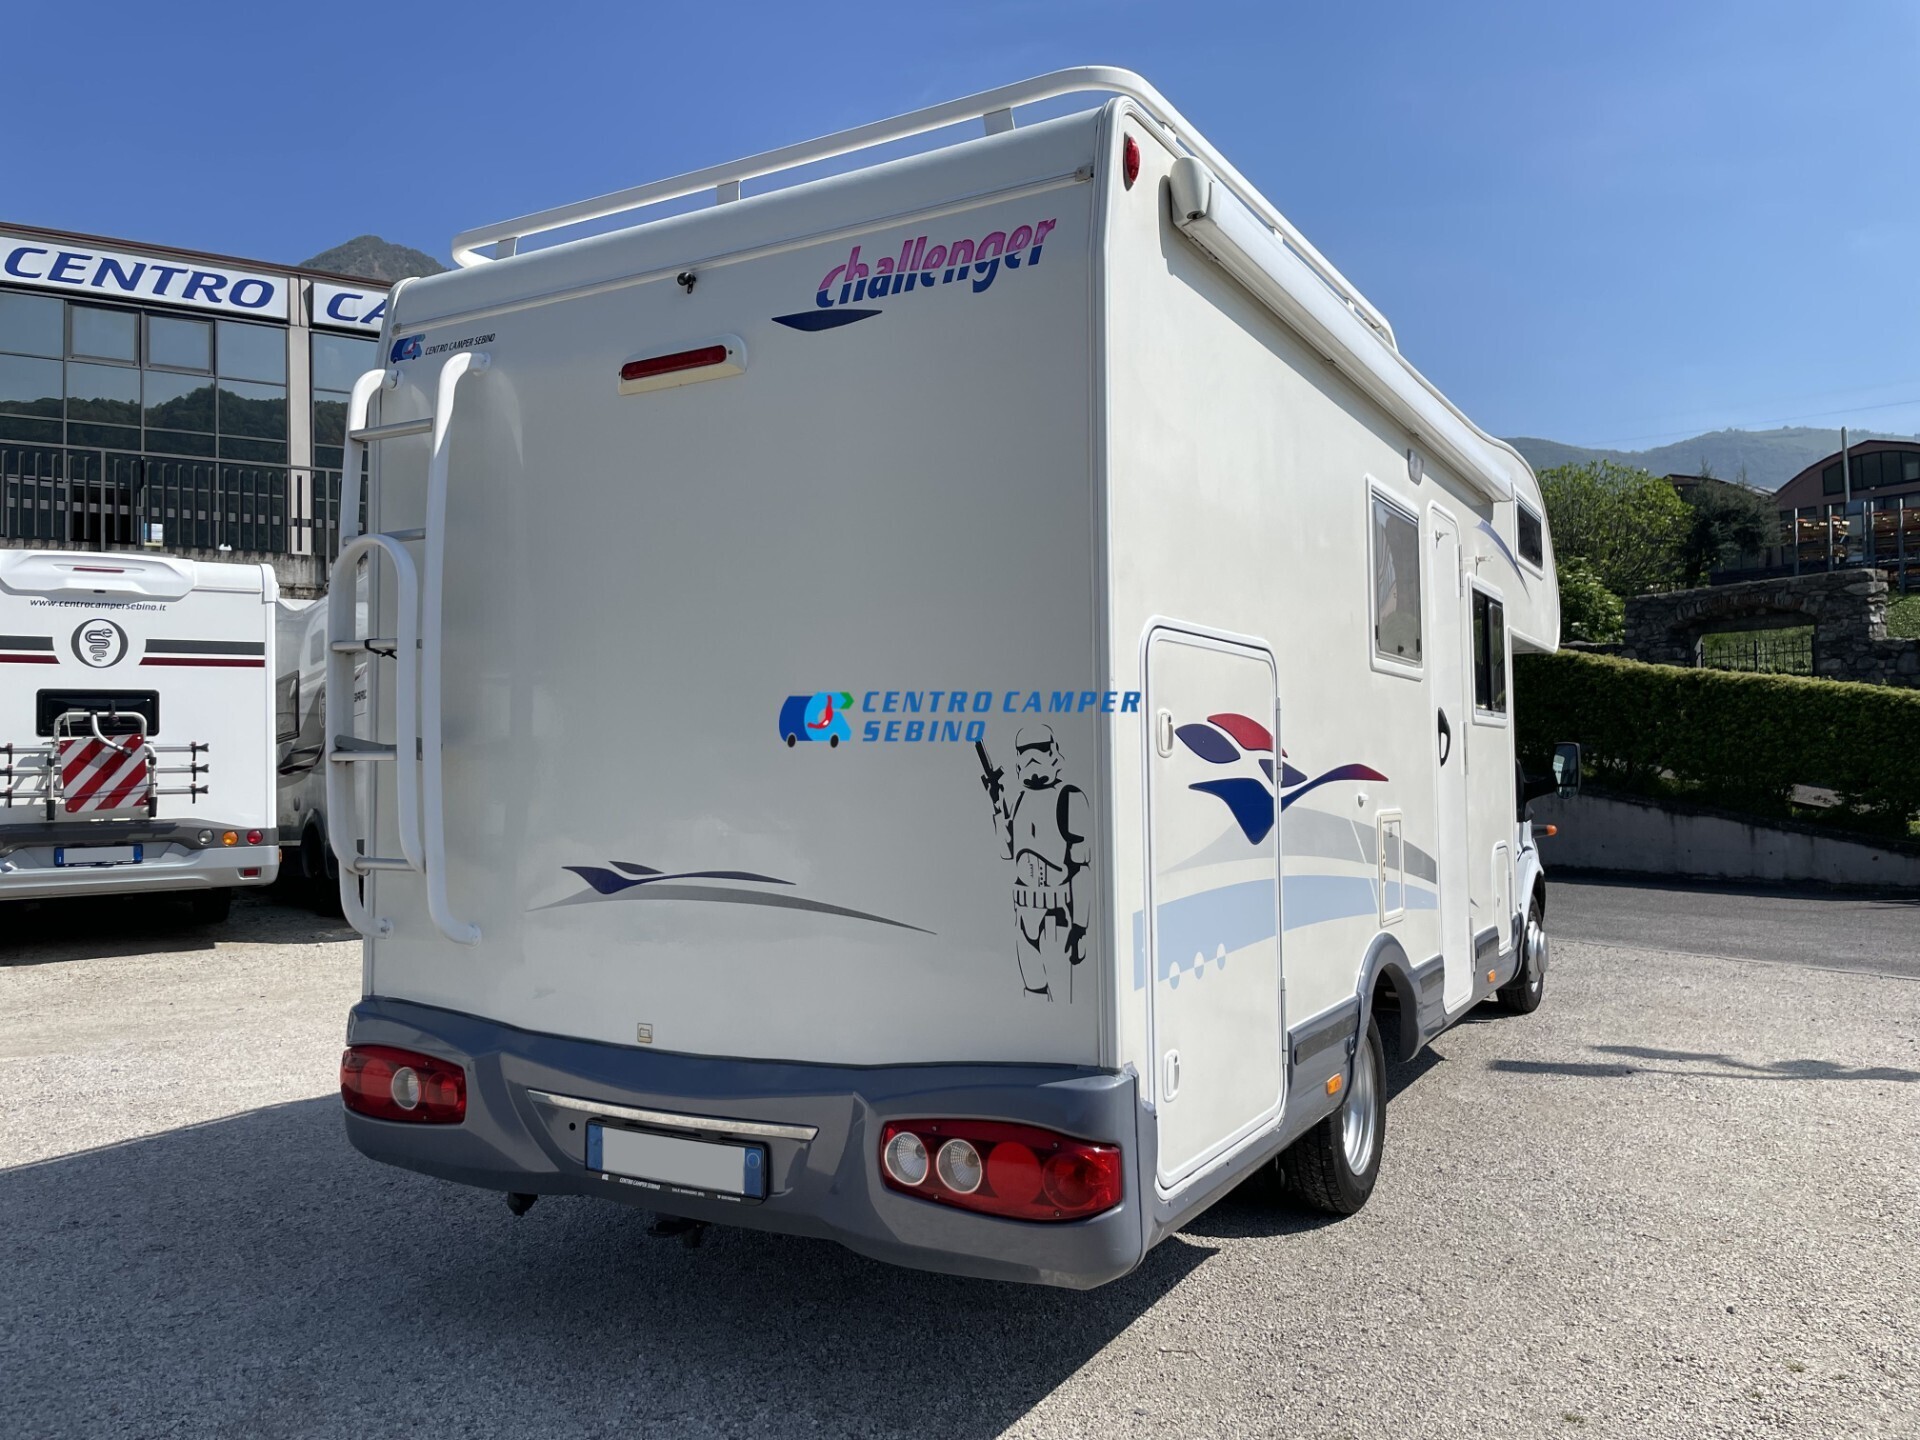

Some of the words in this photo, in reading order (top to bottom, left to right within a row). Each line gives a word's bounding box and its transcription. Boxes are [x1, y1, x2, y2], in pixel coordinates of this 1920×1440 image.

[4, 246, 275, 309] CENTRO
[425, 343, 448, 355] CENTRO
[449, 337, 474, 351] CAMPER
[474, 333, 496, 346] SEBINO
[30, 599, 167, 612] www.centrocampersebino.it
